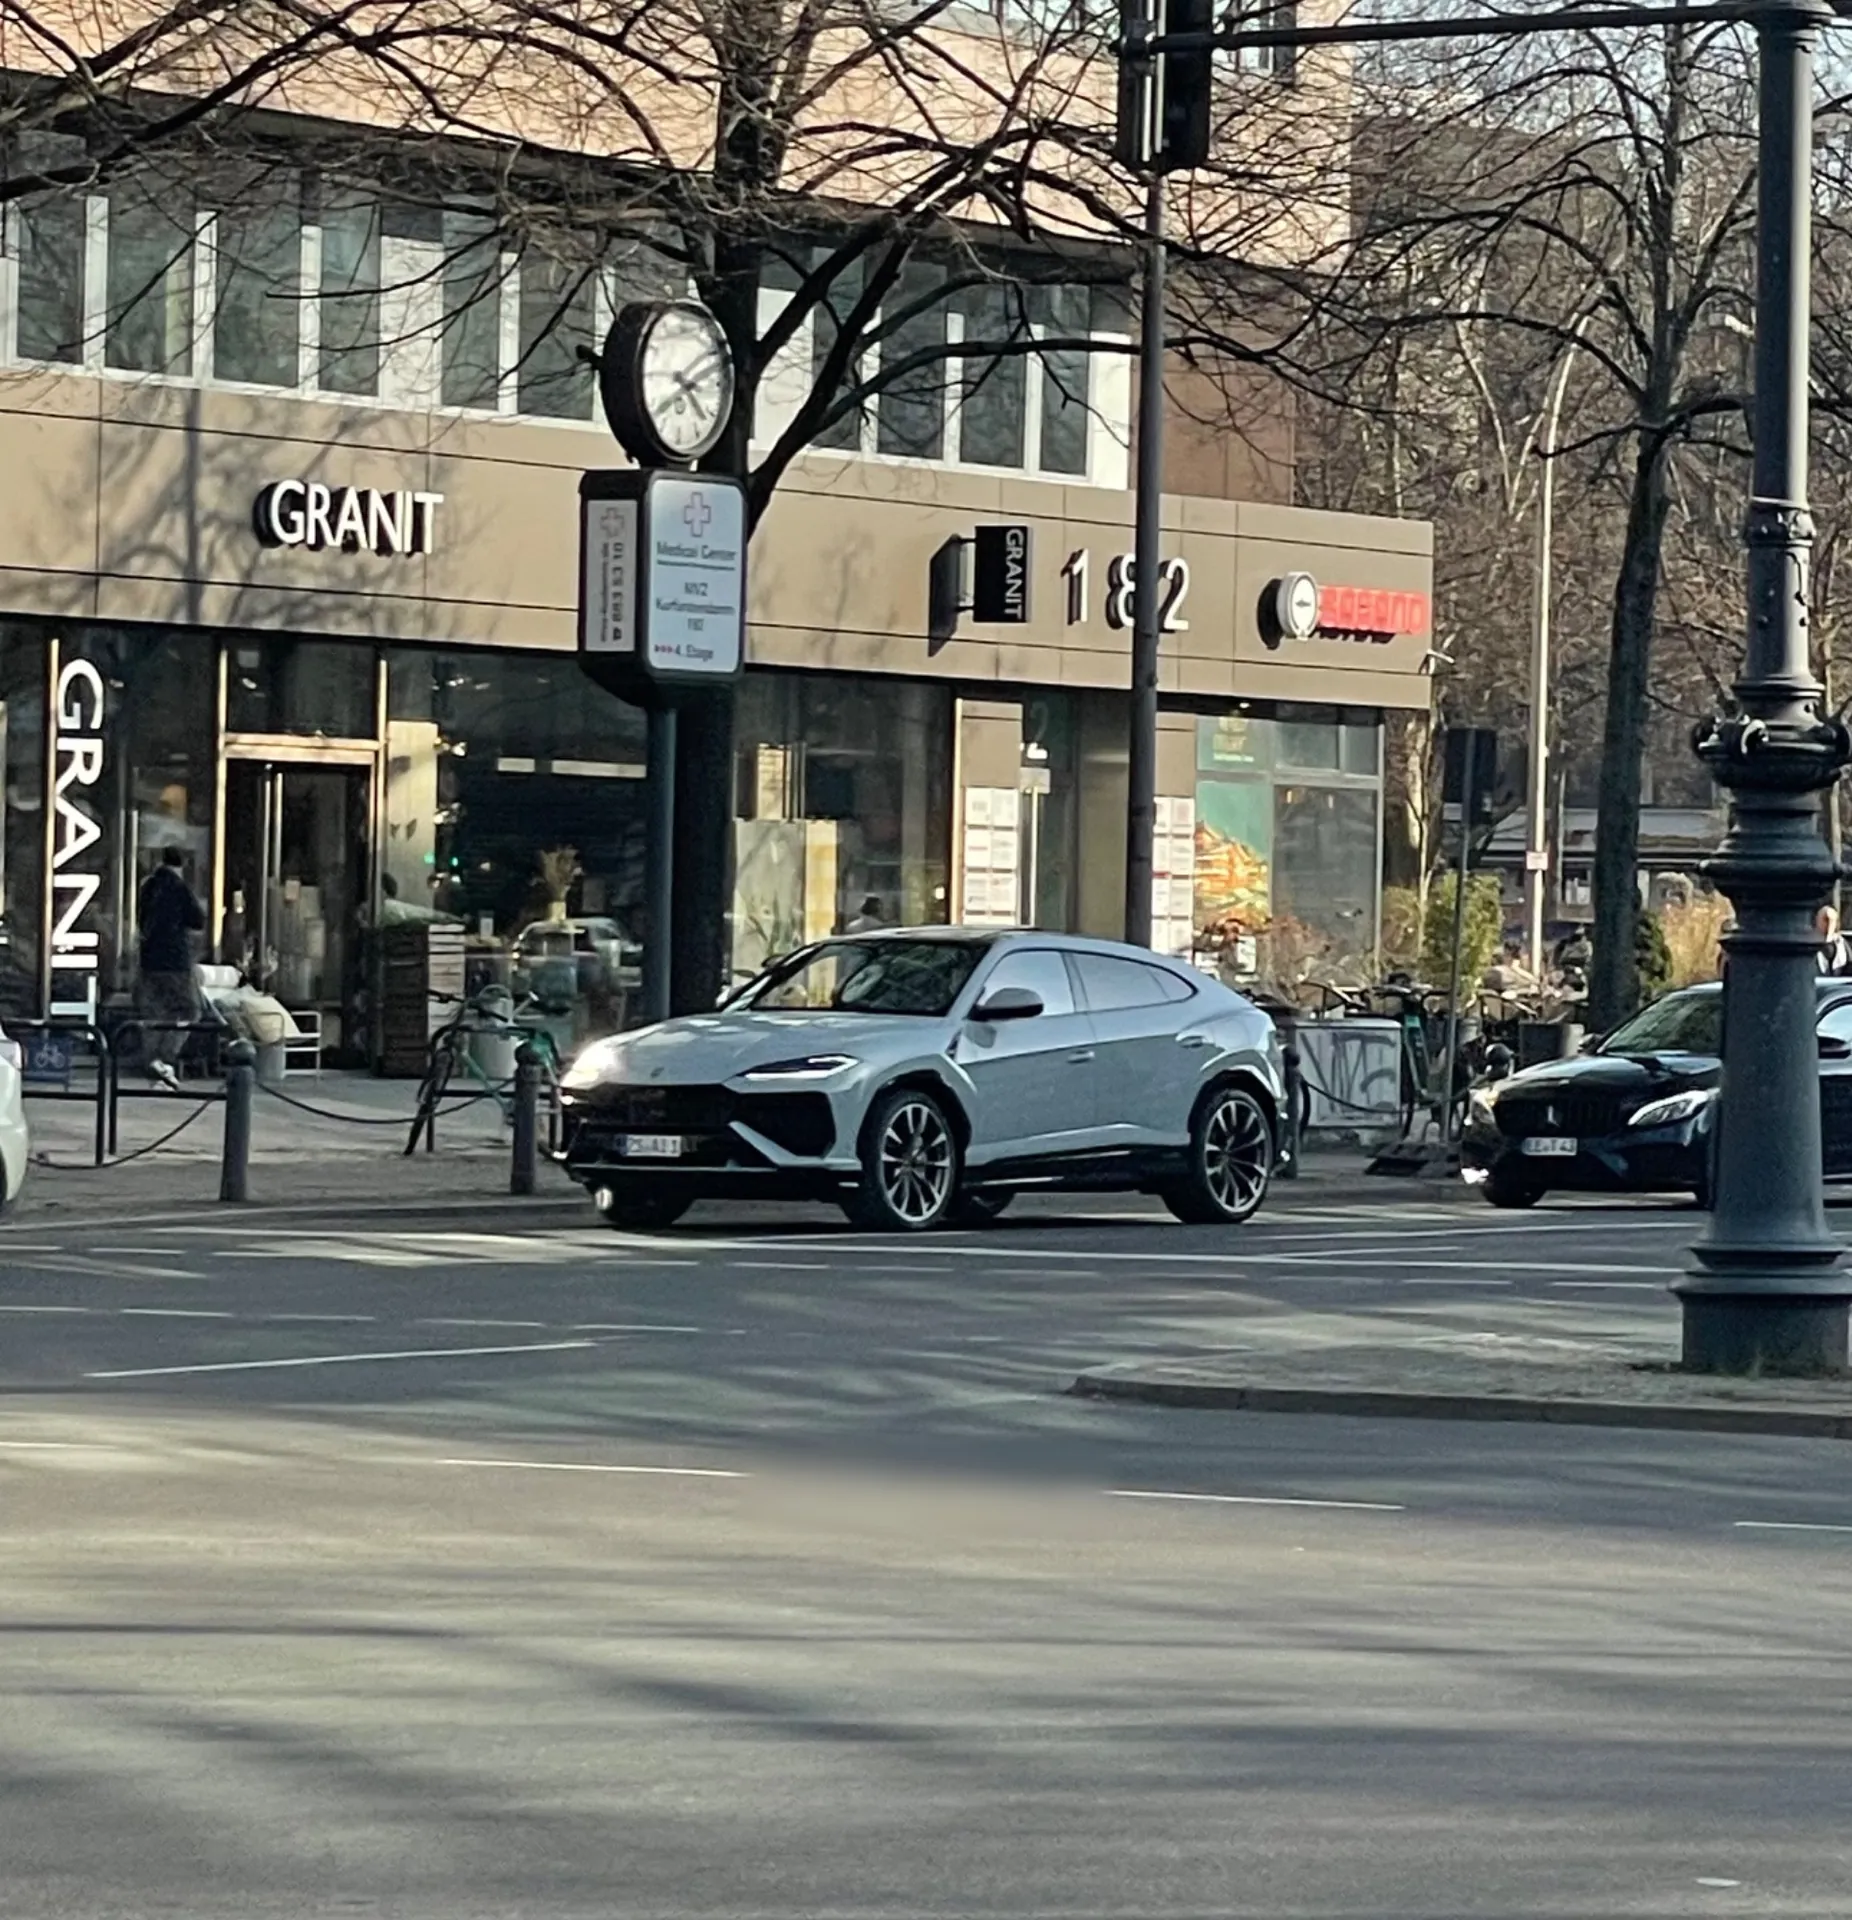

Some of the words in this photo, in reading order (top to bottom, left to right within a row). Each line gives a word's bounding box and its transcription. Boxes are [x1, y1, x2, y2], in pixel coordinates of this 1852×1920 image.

[271, 479, 444, 555] GRANIT
[1004, 528, 1024, 619] GRANIT
[1072, 548, 1190, 631] 182
[50, 658, 104, 1040] GRANIT
